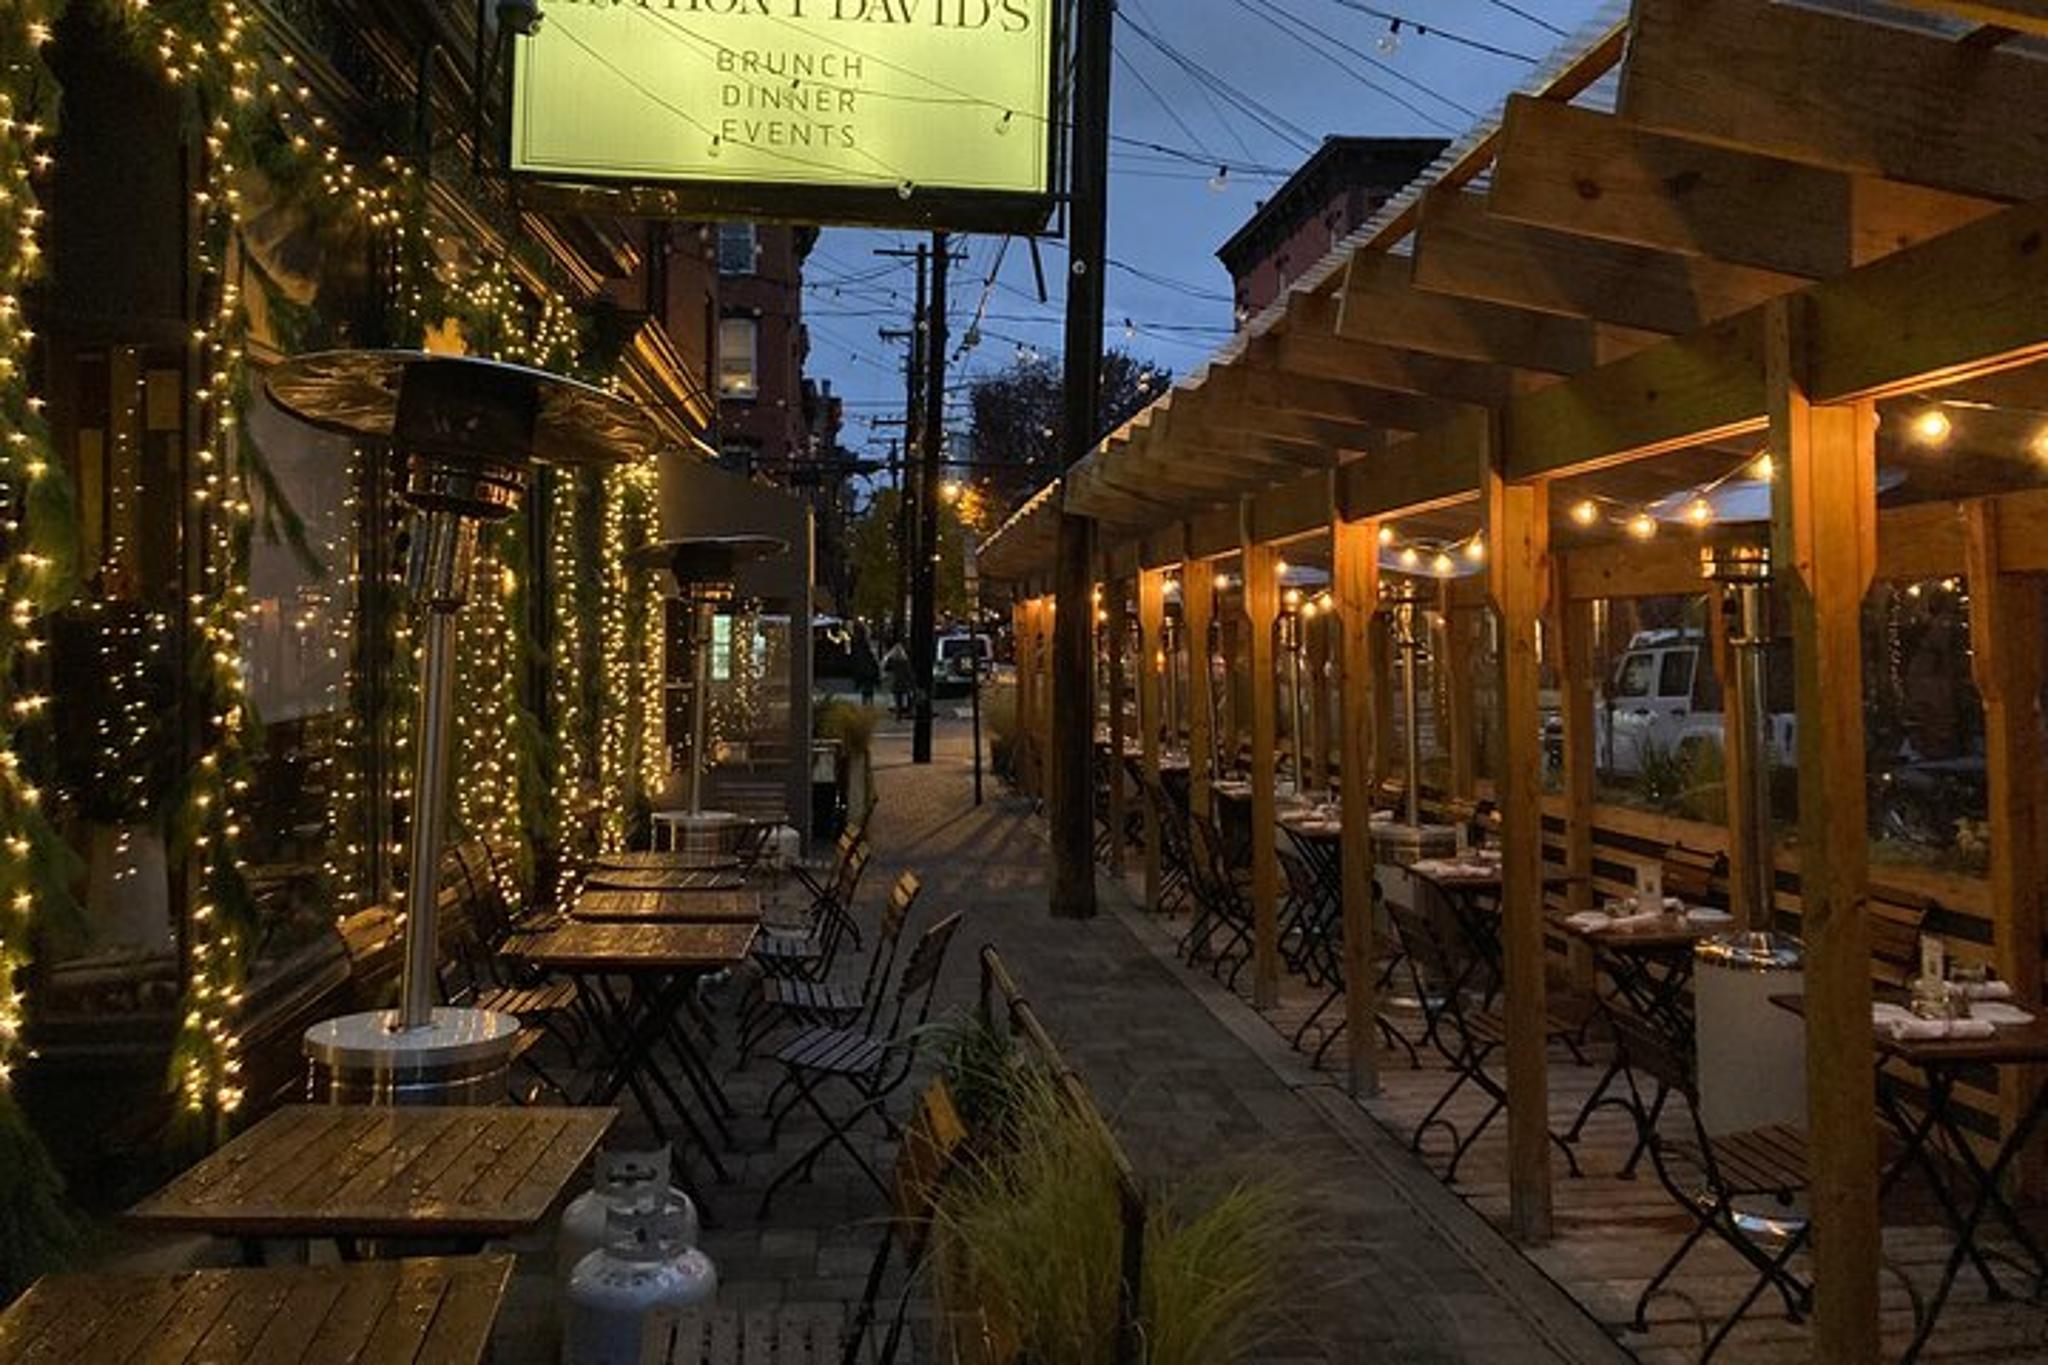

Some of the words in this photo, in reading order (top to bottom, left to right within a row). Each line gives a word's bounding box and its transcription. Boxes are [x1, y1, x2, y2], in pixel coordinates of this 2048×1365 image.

[717, 49, 862, 79] BRUNCH
[722, 84, 856, 114] DINNER
[722, 119, 856, 149] EVENTS
